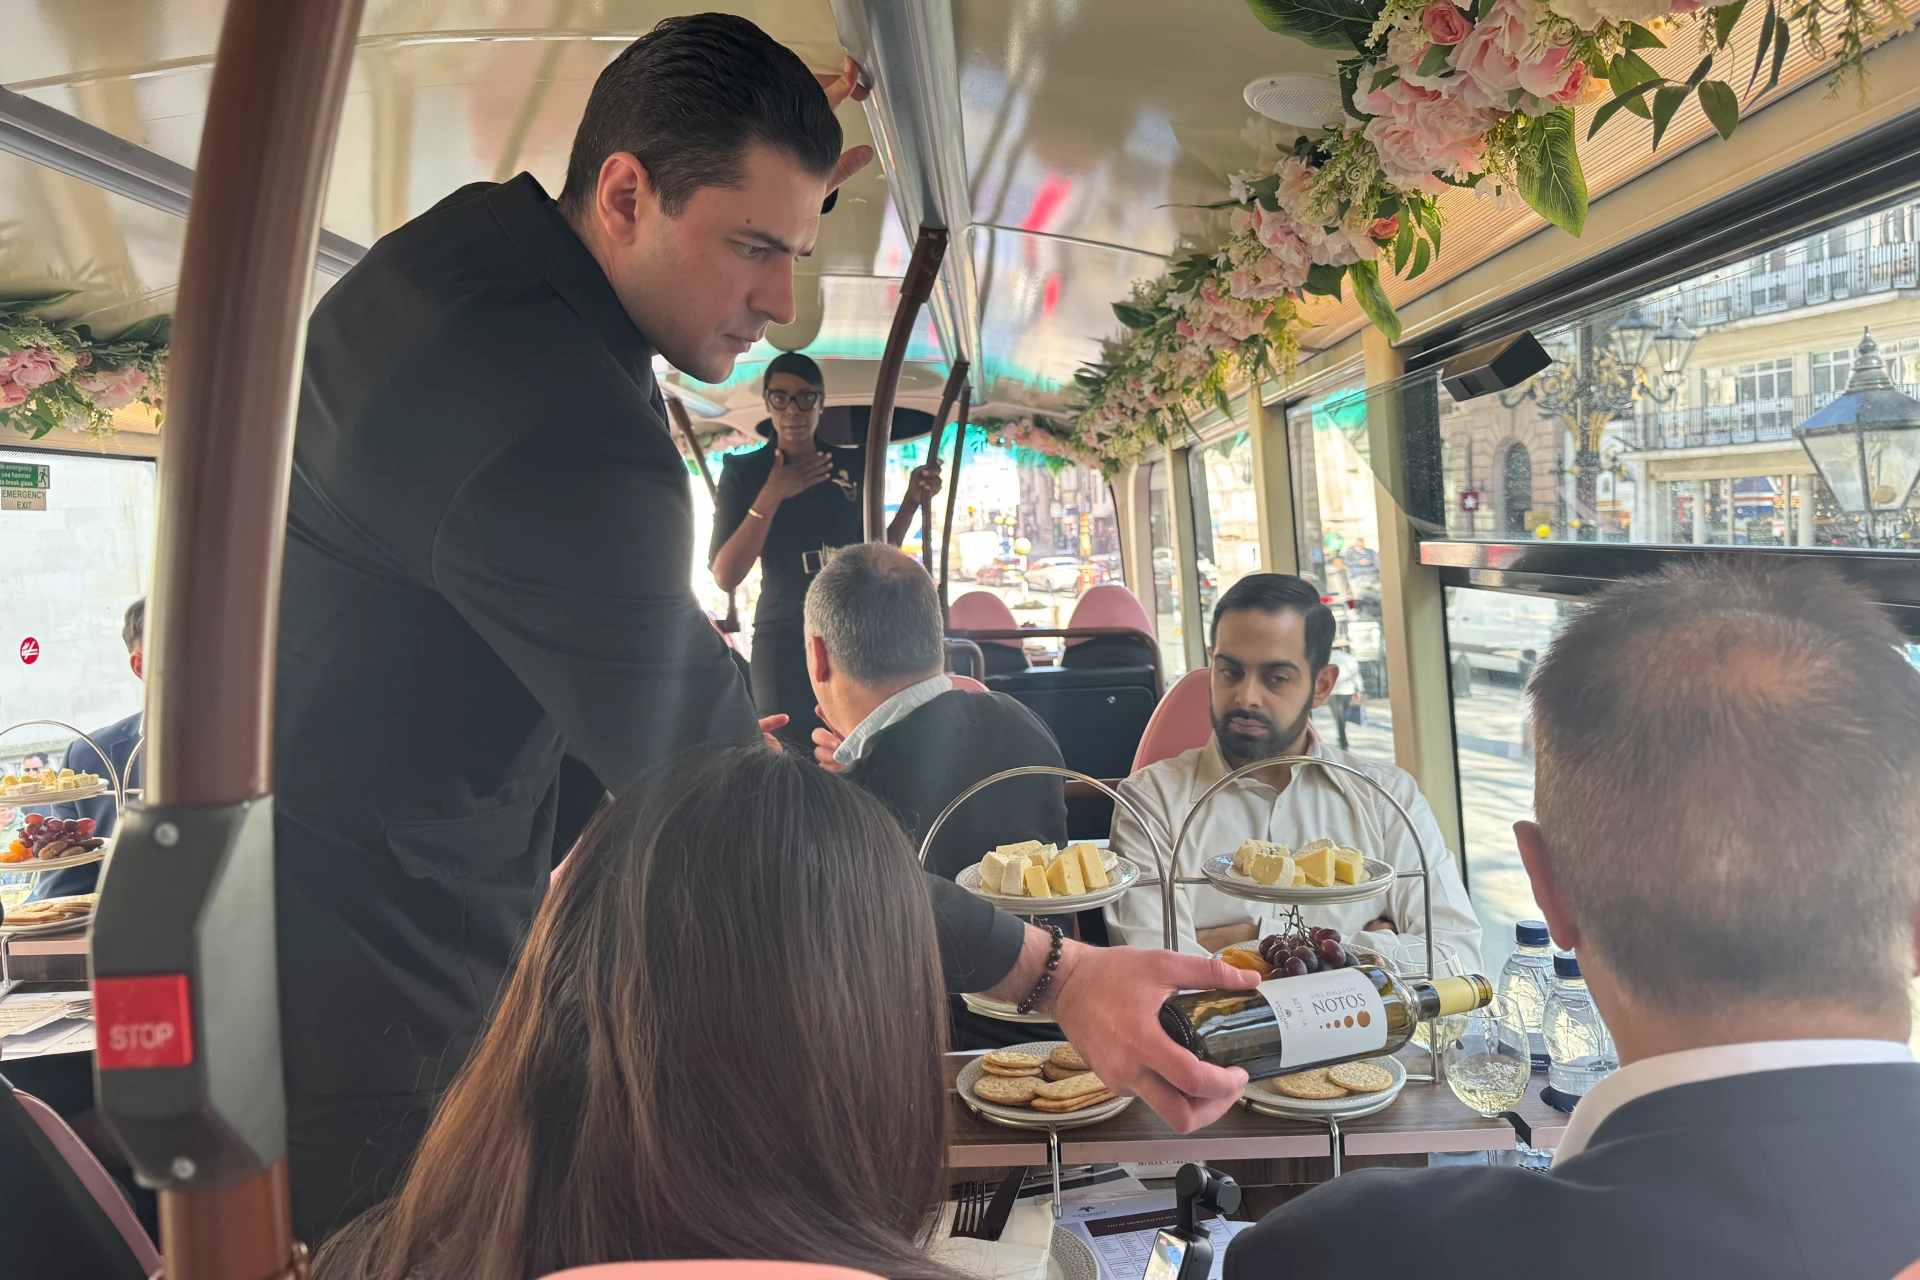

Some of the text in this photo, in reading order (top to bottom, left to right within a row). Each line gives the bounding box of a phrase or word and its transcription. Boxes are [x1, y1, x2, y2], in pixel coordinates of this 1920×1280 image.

[2, 490, 46, 499] EMERGENCY
[16, 500, 32, 509] EXIT
[1312, 993, 1366, 1014] NOTOS
[108, 1022, 175, 1051] STOP
